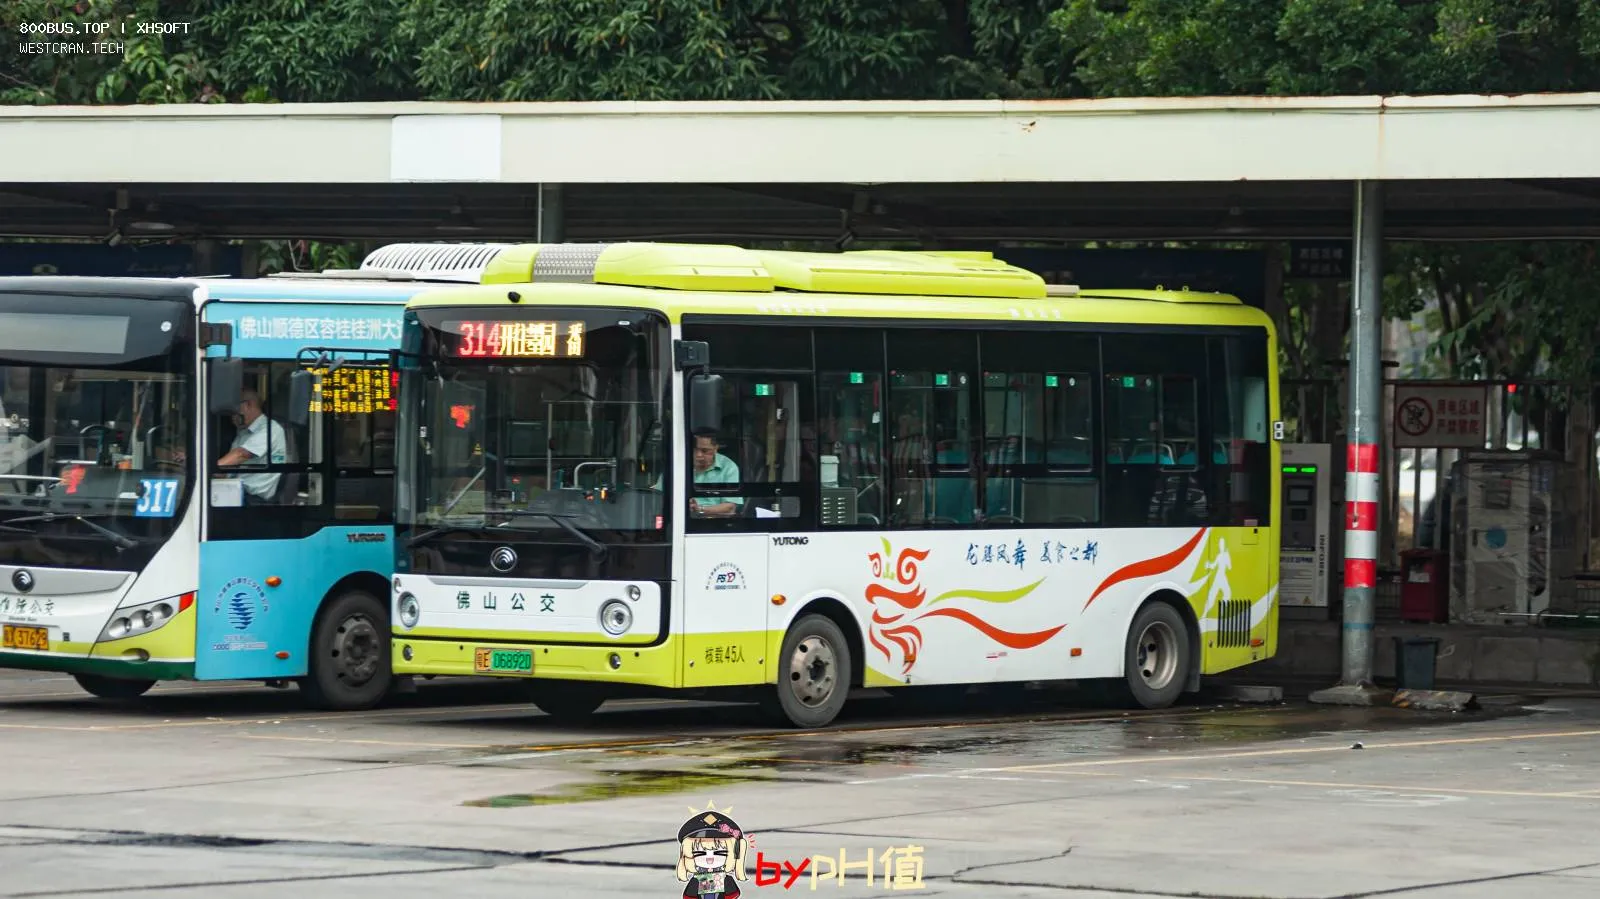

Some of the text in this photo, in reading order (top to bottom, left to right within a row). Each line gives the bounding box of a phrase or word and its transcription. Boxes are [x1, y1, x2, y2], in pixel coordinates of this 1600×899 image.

[459, 321, 500, 356] 314
[137, 480, 178, 512] 317
[772, 536, 809, 546] YUTONG
[456, 590, 556, 613] 佛山公交
[705, 645, 745, 665] 核载45人
